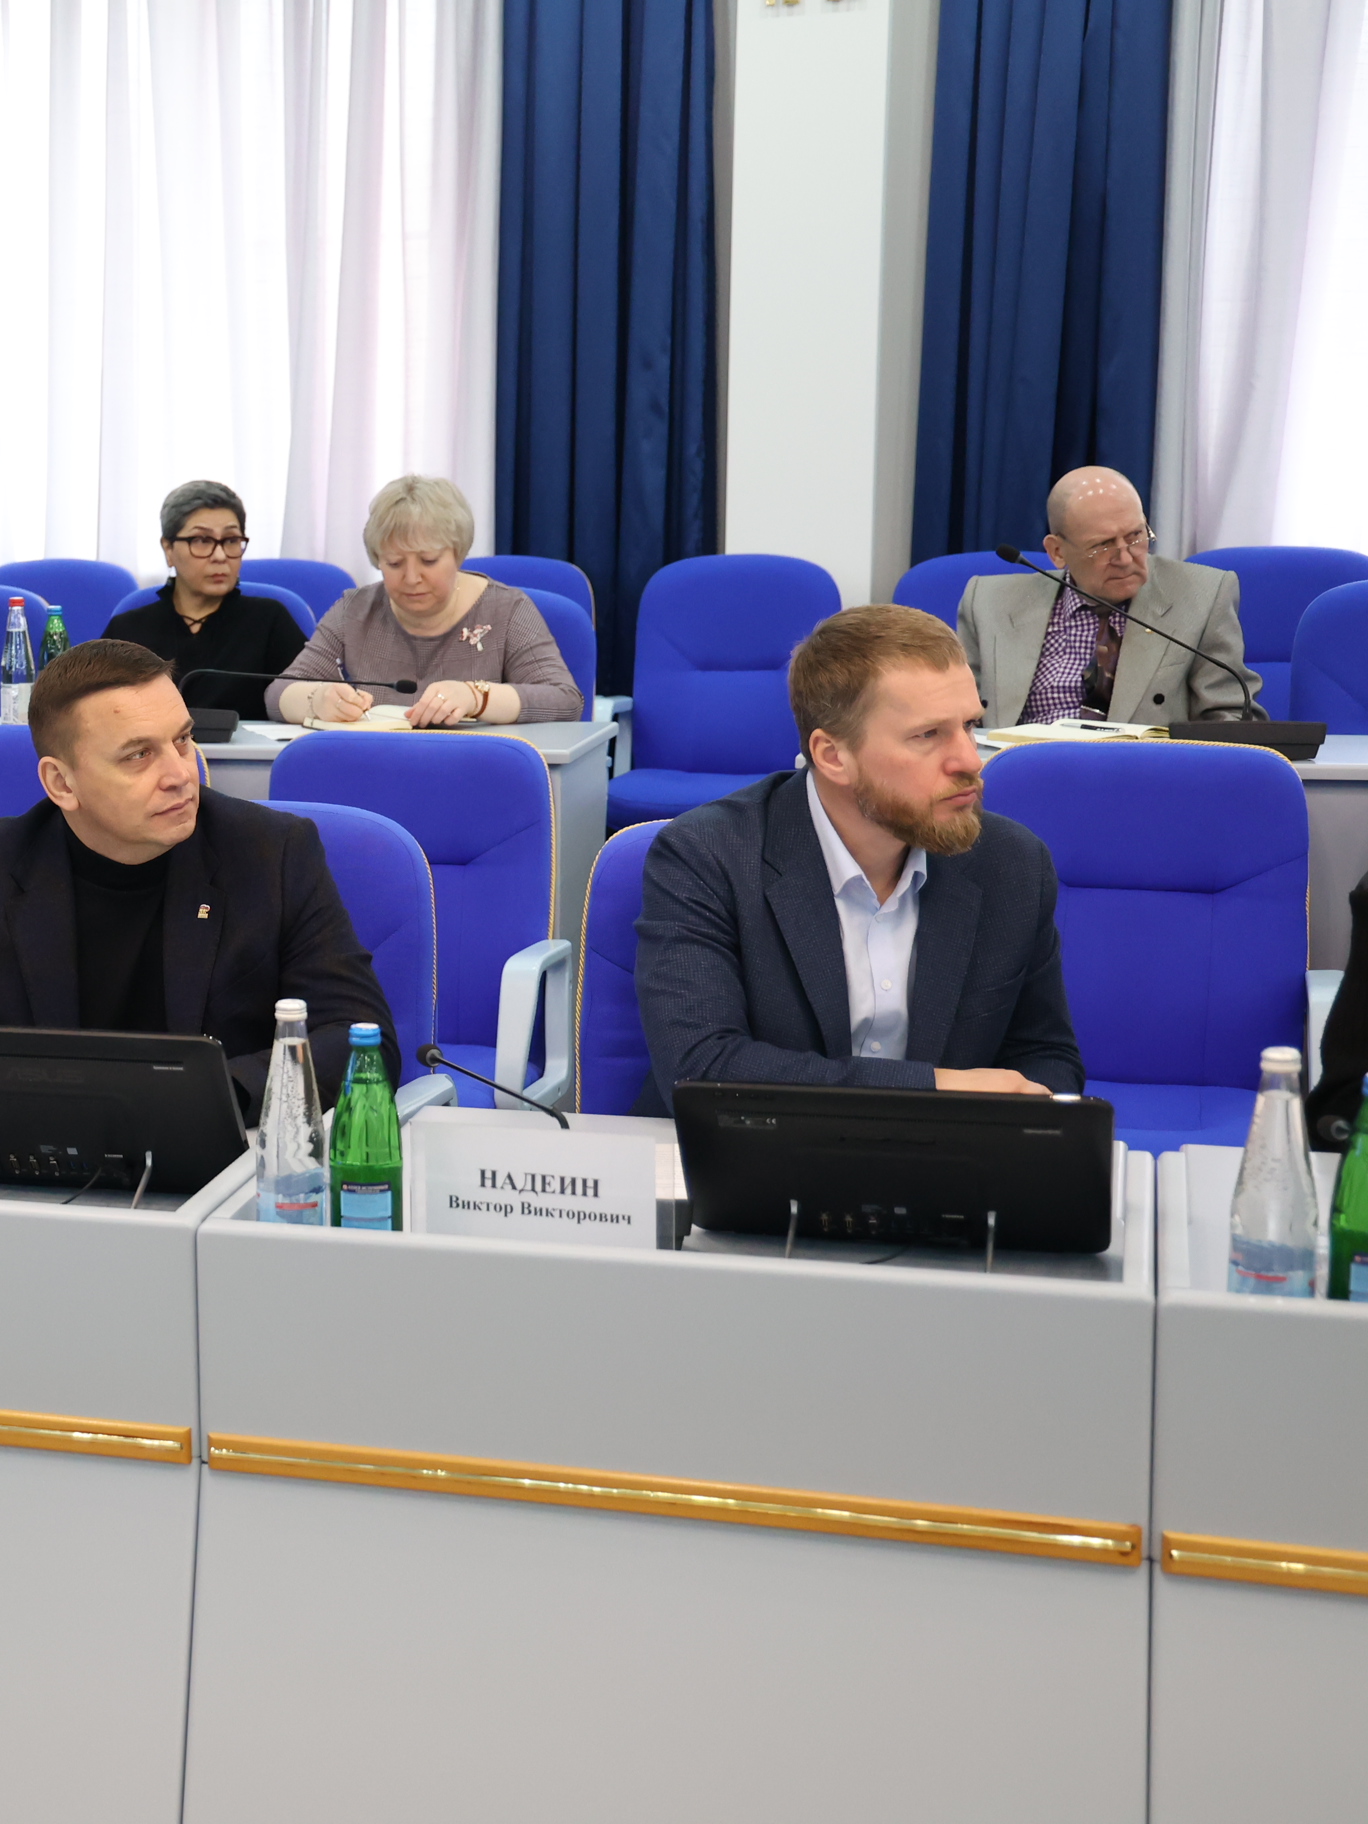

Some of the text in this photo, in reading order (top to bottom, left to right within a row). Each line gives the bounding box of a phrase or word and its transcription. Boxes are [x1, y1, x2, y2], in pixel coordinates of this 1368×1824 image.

[479, 1168, 600, 1198] НАДЕИН
[448, 1194, 632, 1225] Виктор Викторович
